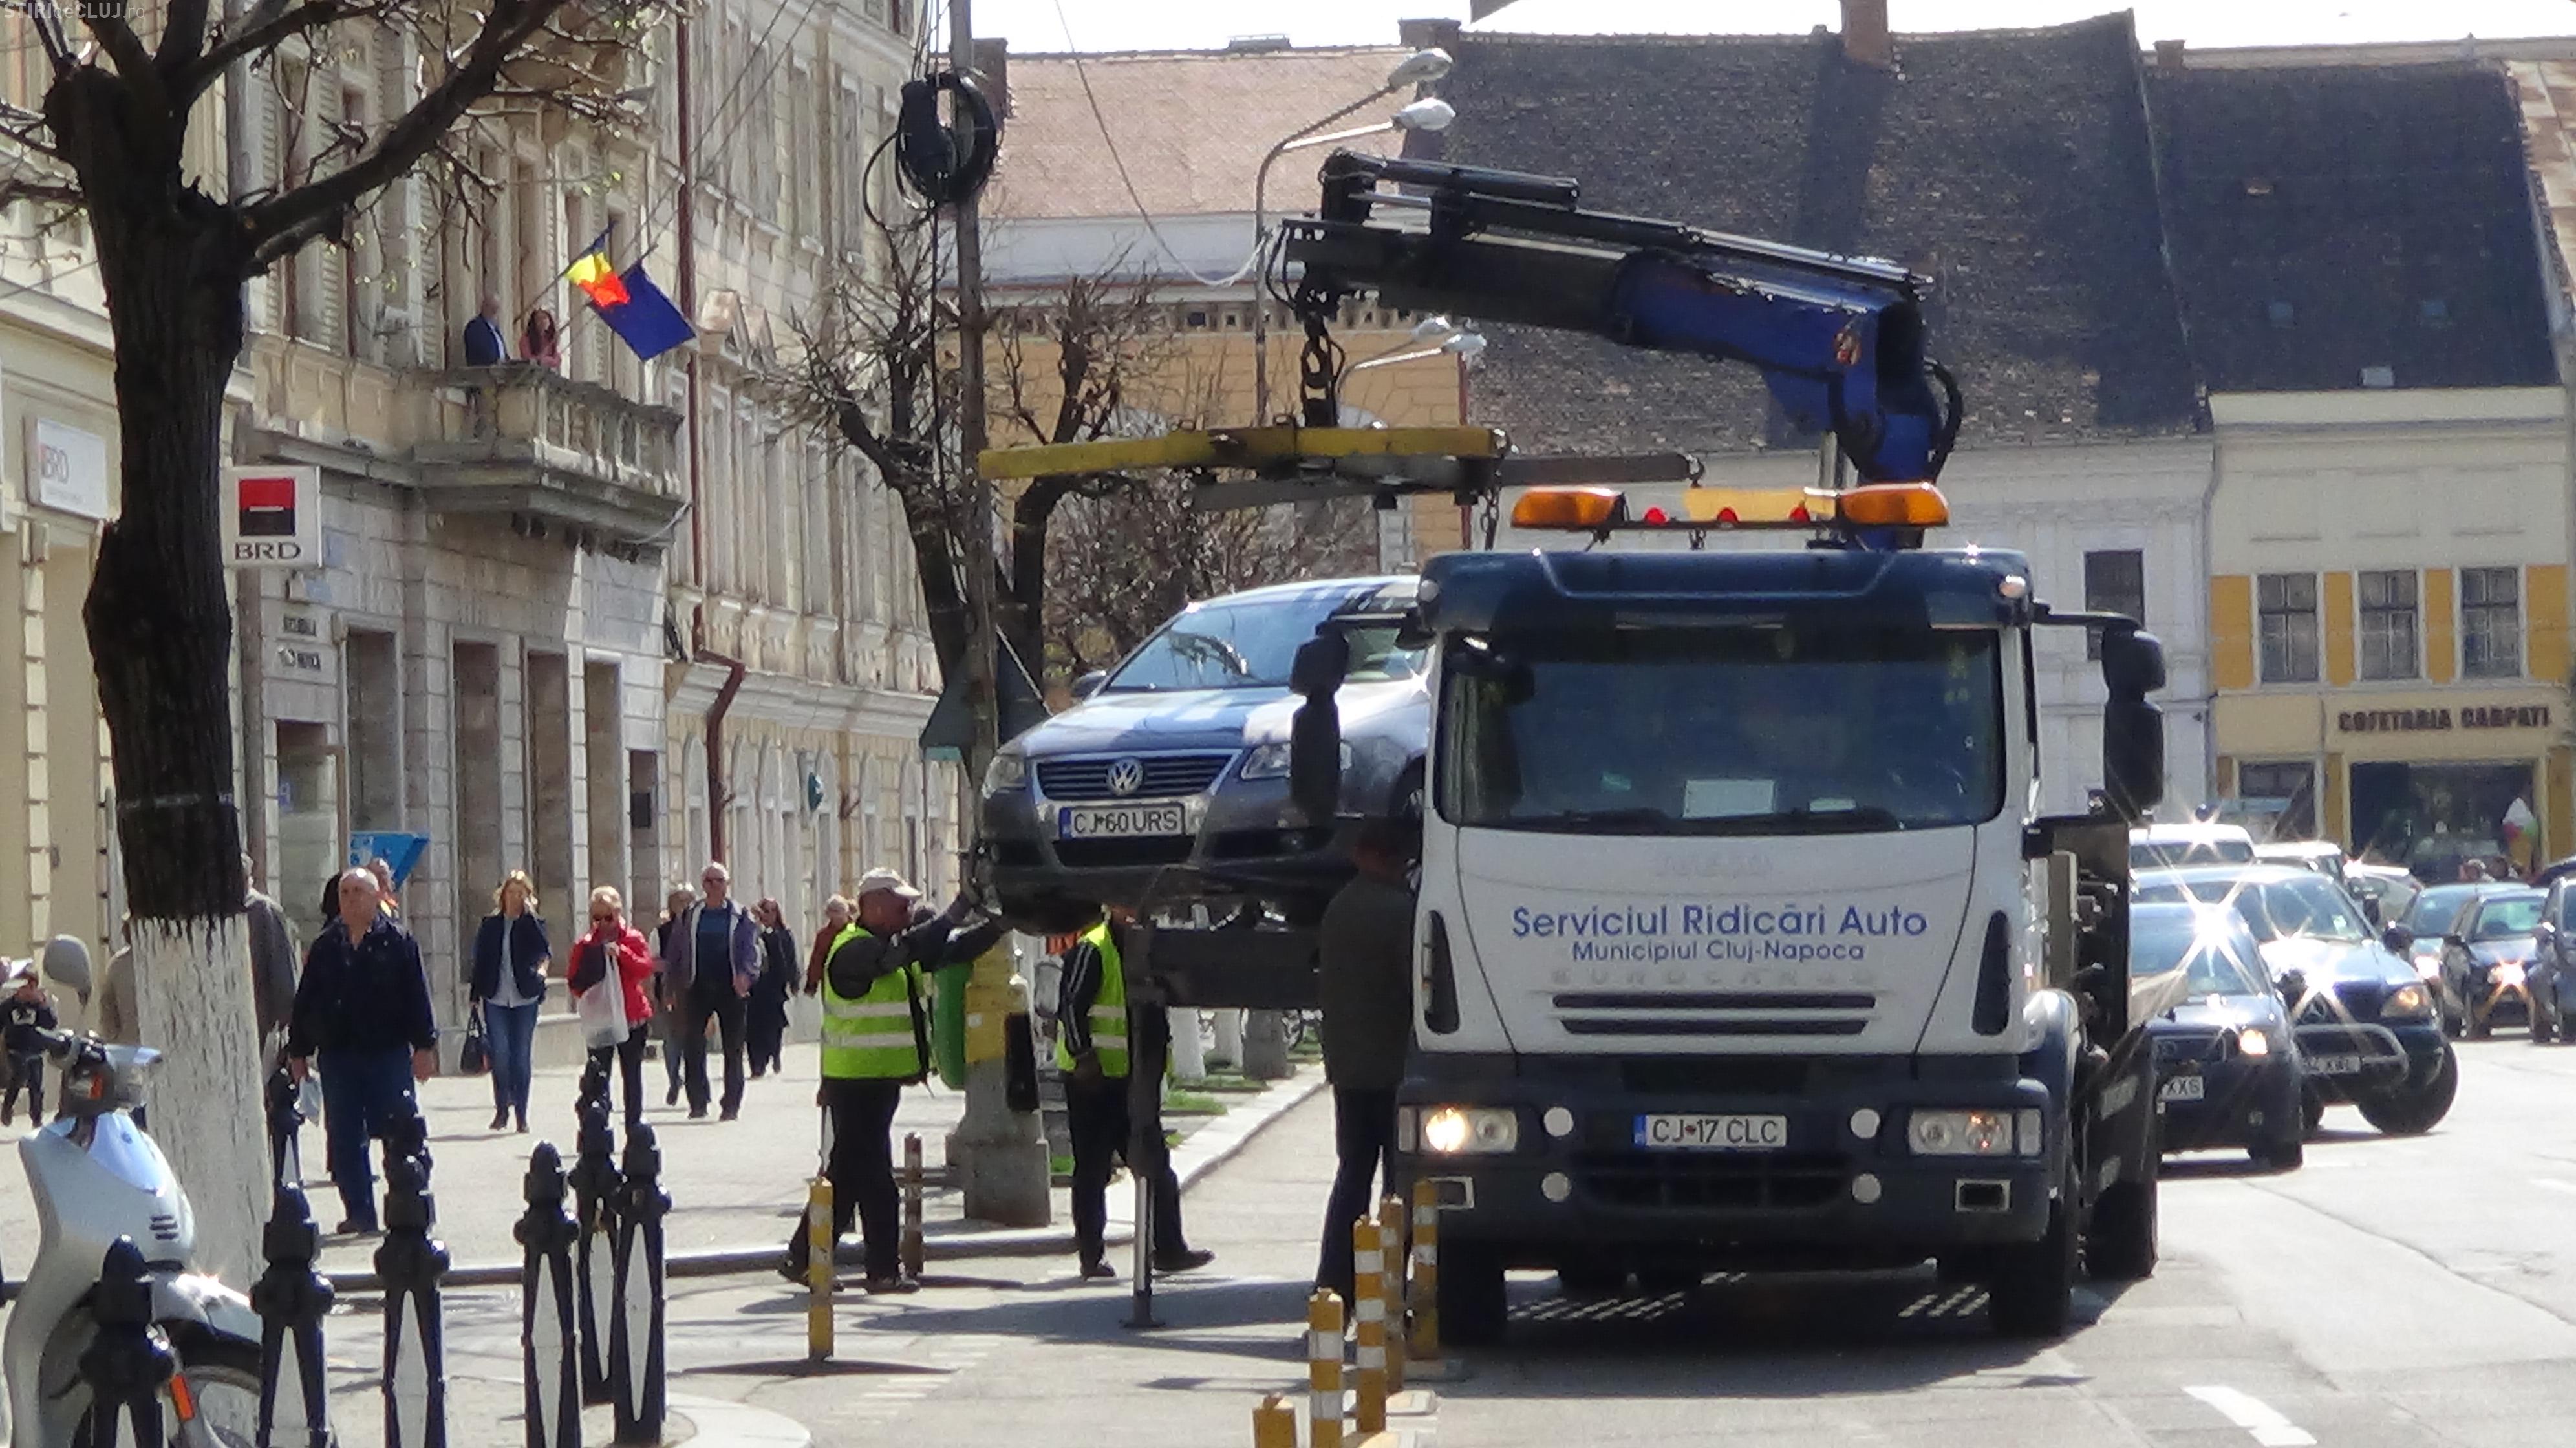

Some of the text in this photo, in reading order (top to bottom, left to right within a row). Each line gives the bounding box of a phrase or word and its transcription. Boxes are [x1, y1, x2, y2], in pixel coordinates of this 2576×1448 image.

[235, 542, 301, 560] BRD
[1132, 811, 1177, 833] URS
[1513, 905, 1667, 937] Serviciul
[1839, 906, 1927, 936] Auto
[1572, 940, 1864, 964] Municipiul Cluj-Napoca
[1653, 1119, 1777, 1144] CJ 17 CLC
